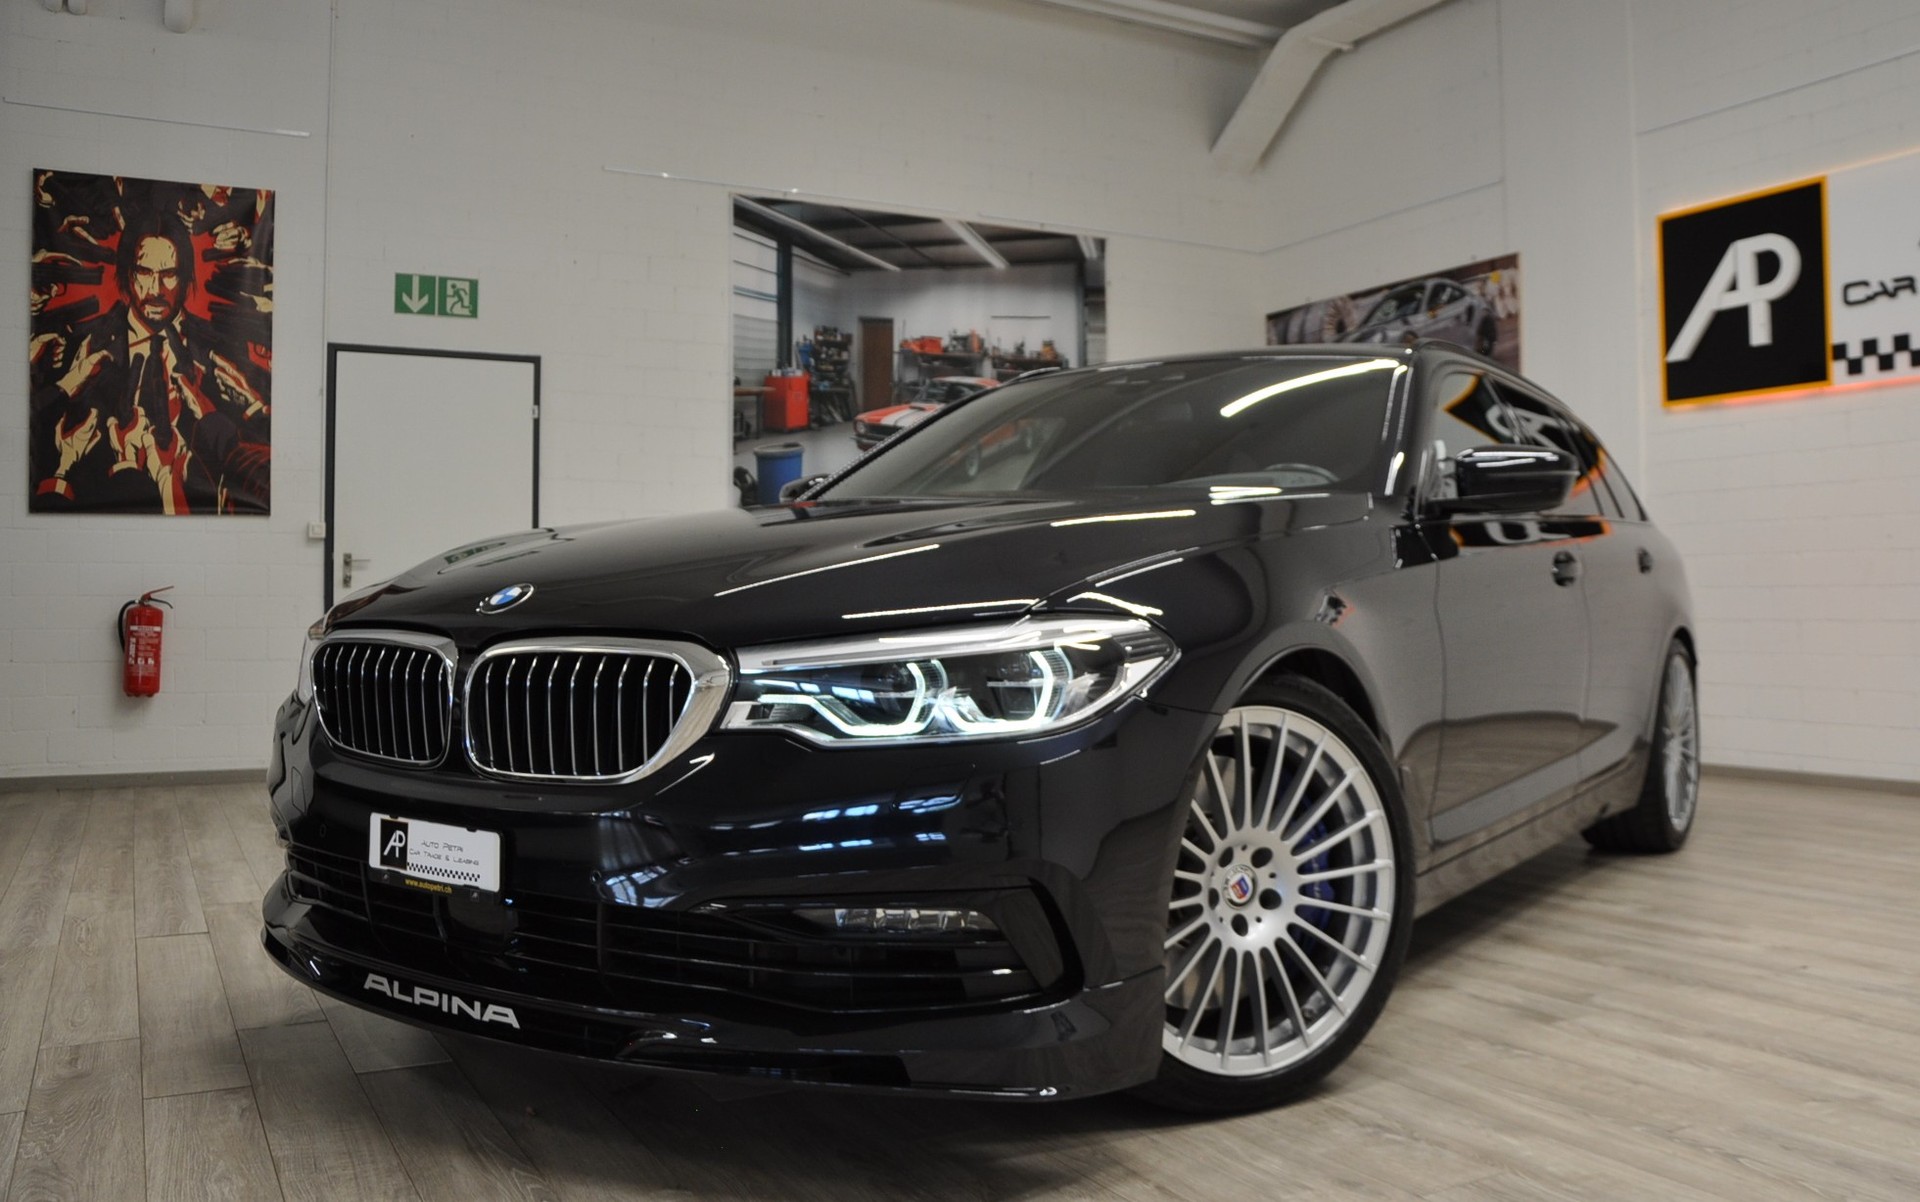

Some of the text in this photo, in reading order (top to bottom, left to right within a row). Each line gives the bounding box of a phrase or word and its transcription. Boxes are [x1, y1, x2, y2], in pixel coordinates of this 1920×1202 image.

[1665, 232, 1802, 363] AP
[1842, 275, 1917, 307] CAR
[383, 829, 406, 858] AP
[421, 840, 439, 849] AUTO
[363, 972, 521, 1029] ALPINA
